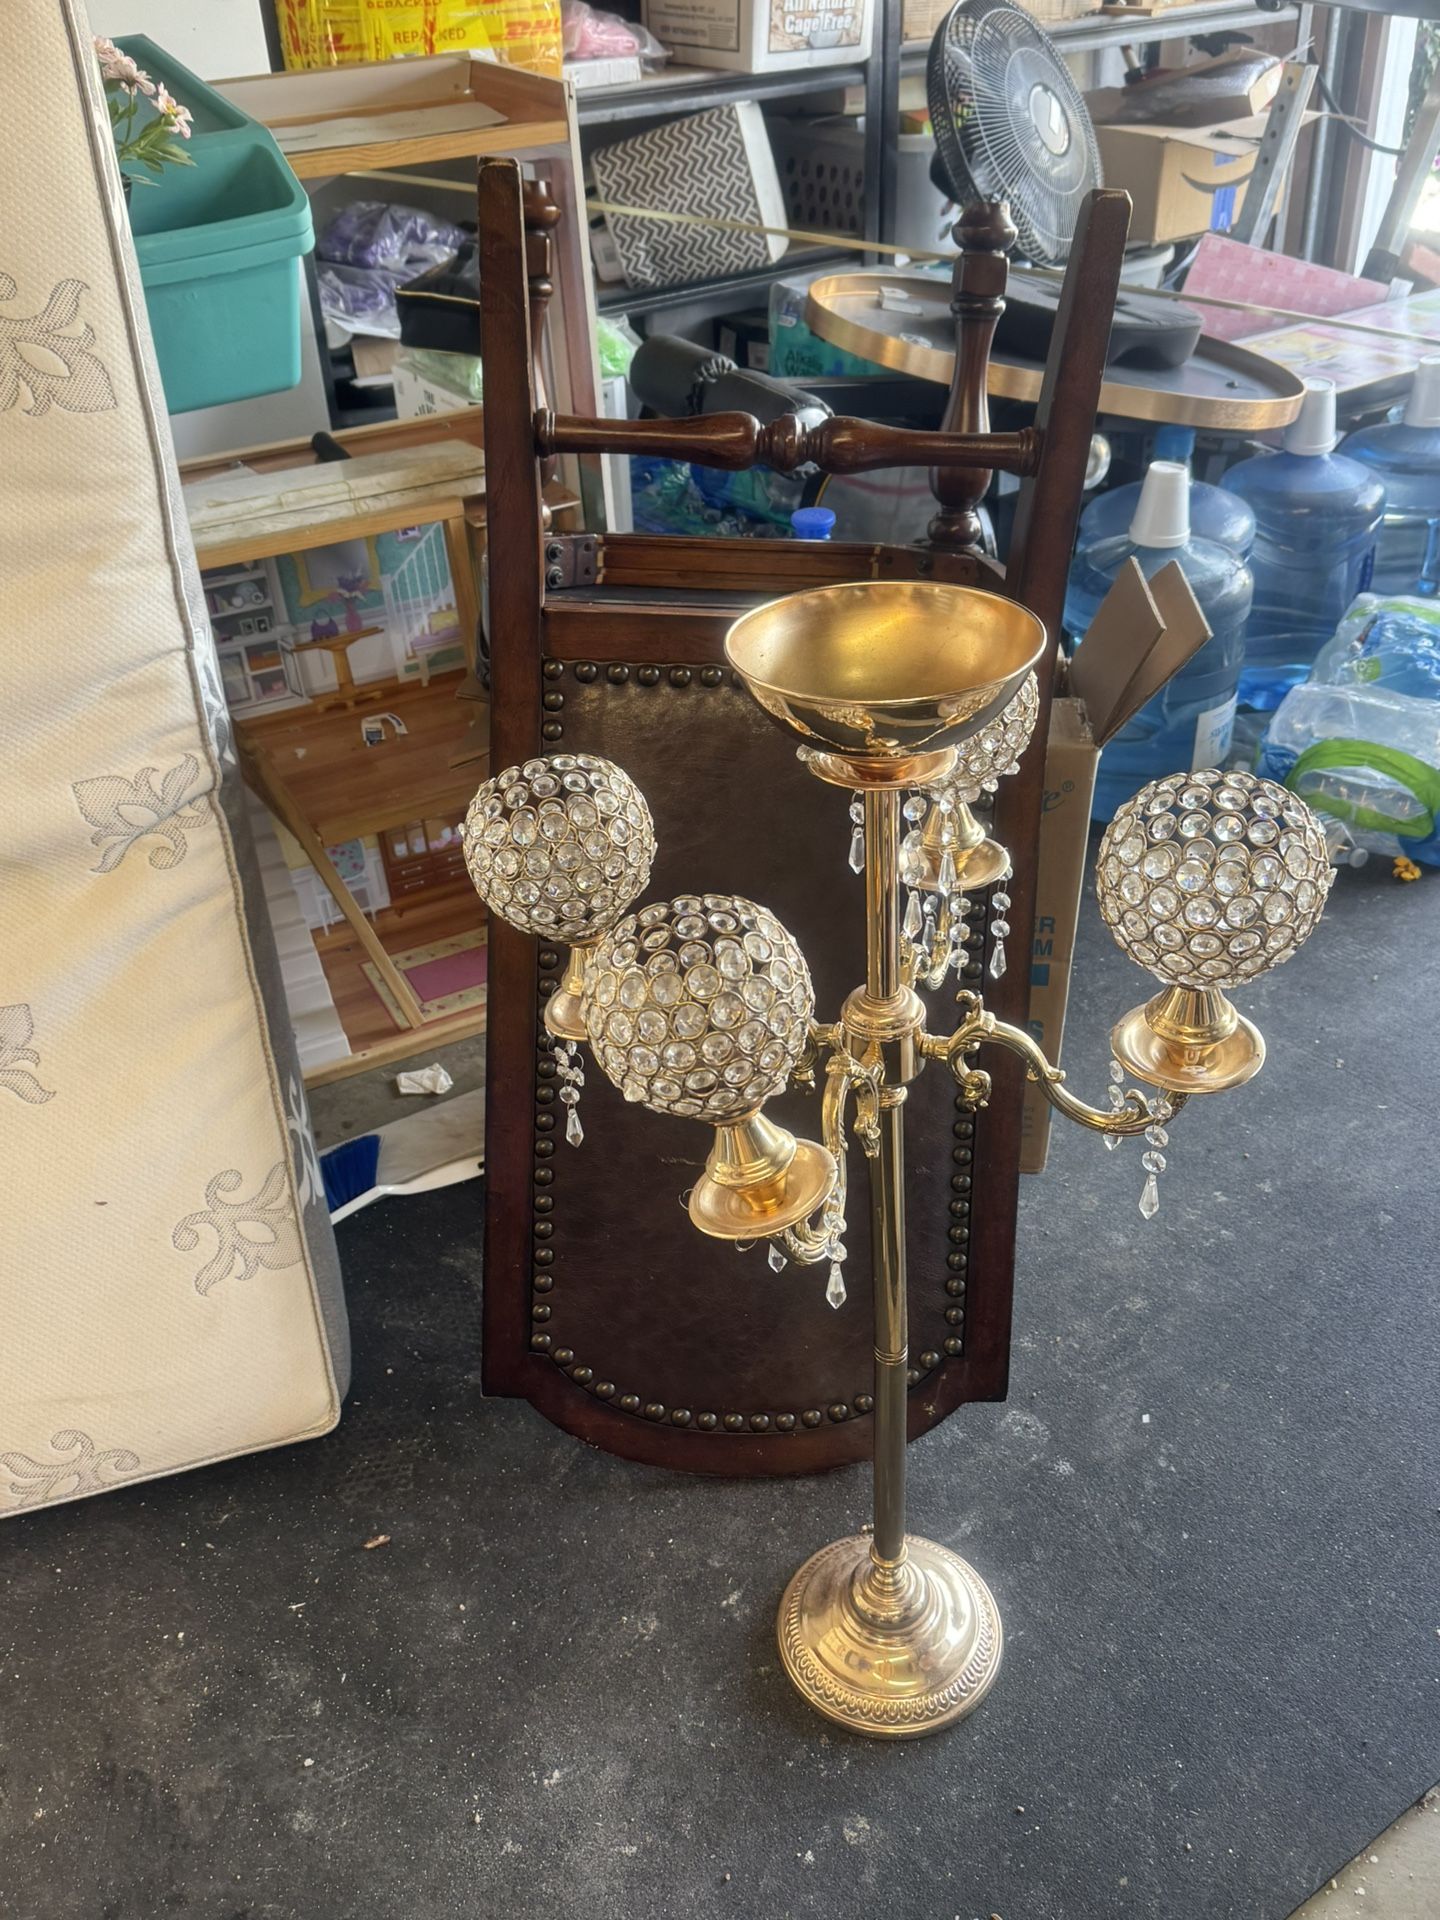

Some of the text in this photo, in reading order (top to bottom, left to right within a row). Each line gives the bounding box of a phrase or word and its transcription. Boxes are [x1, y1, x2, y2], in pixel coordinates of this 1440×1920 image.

[784, 13, 853, 37] Cage Free
[393, 27, 466, 44] REPAKED
